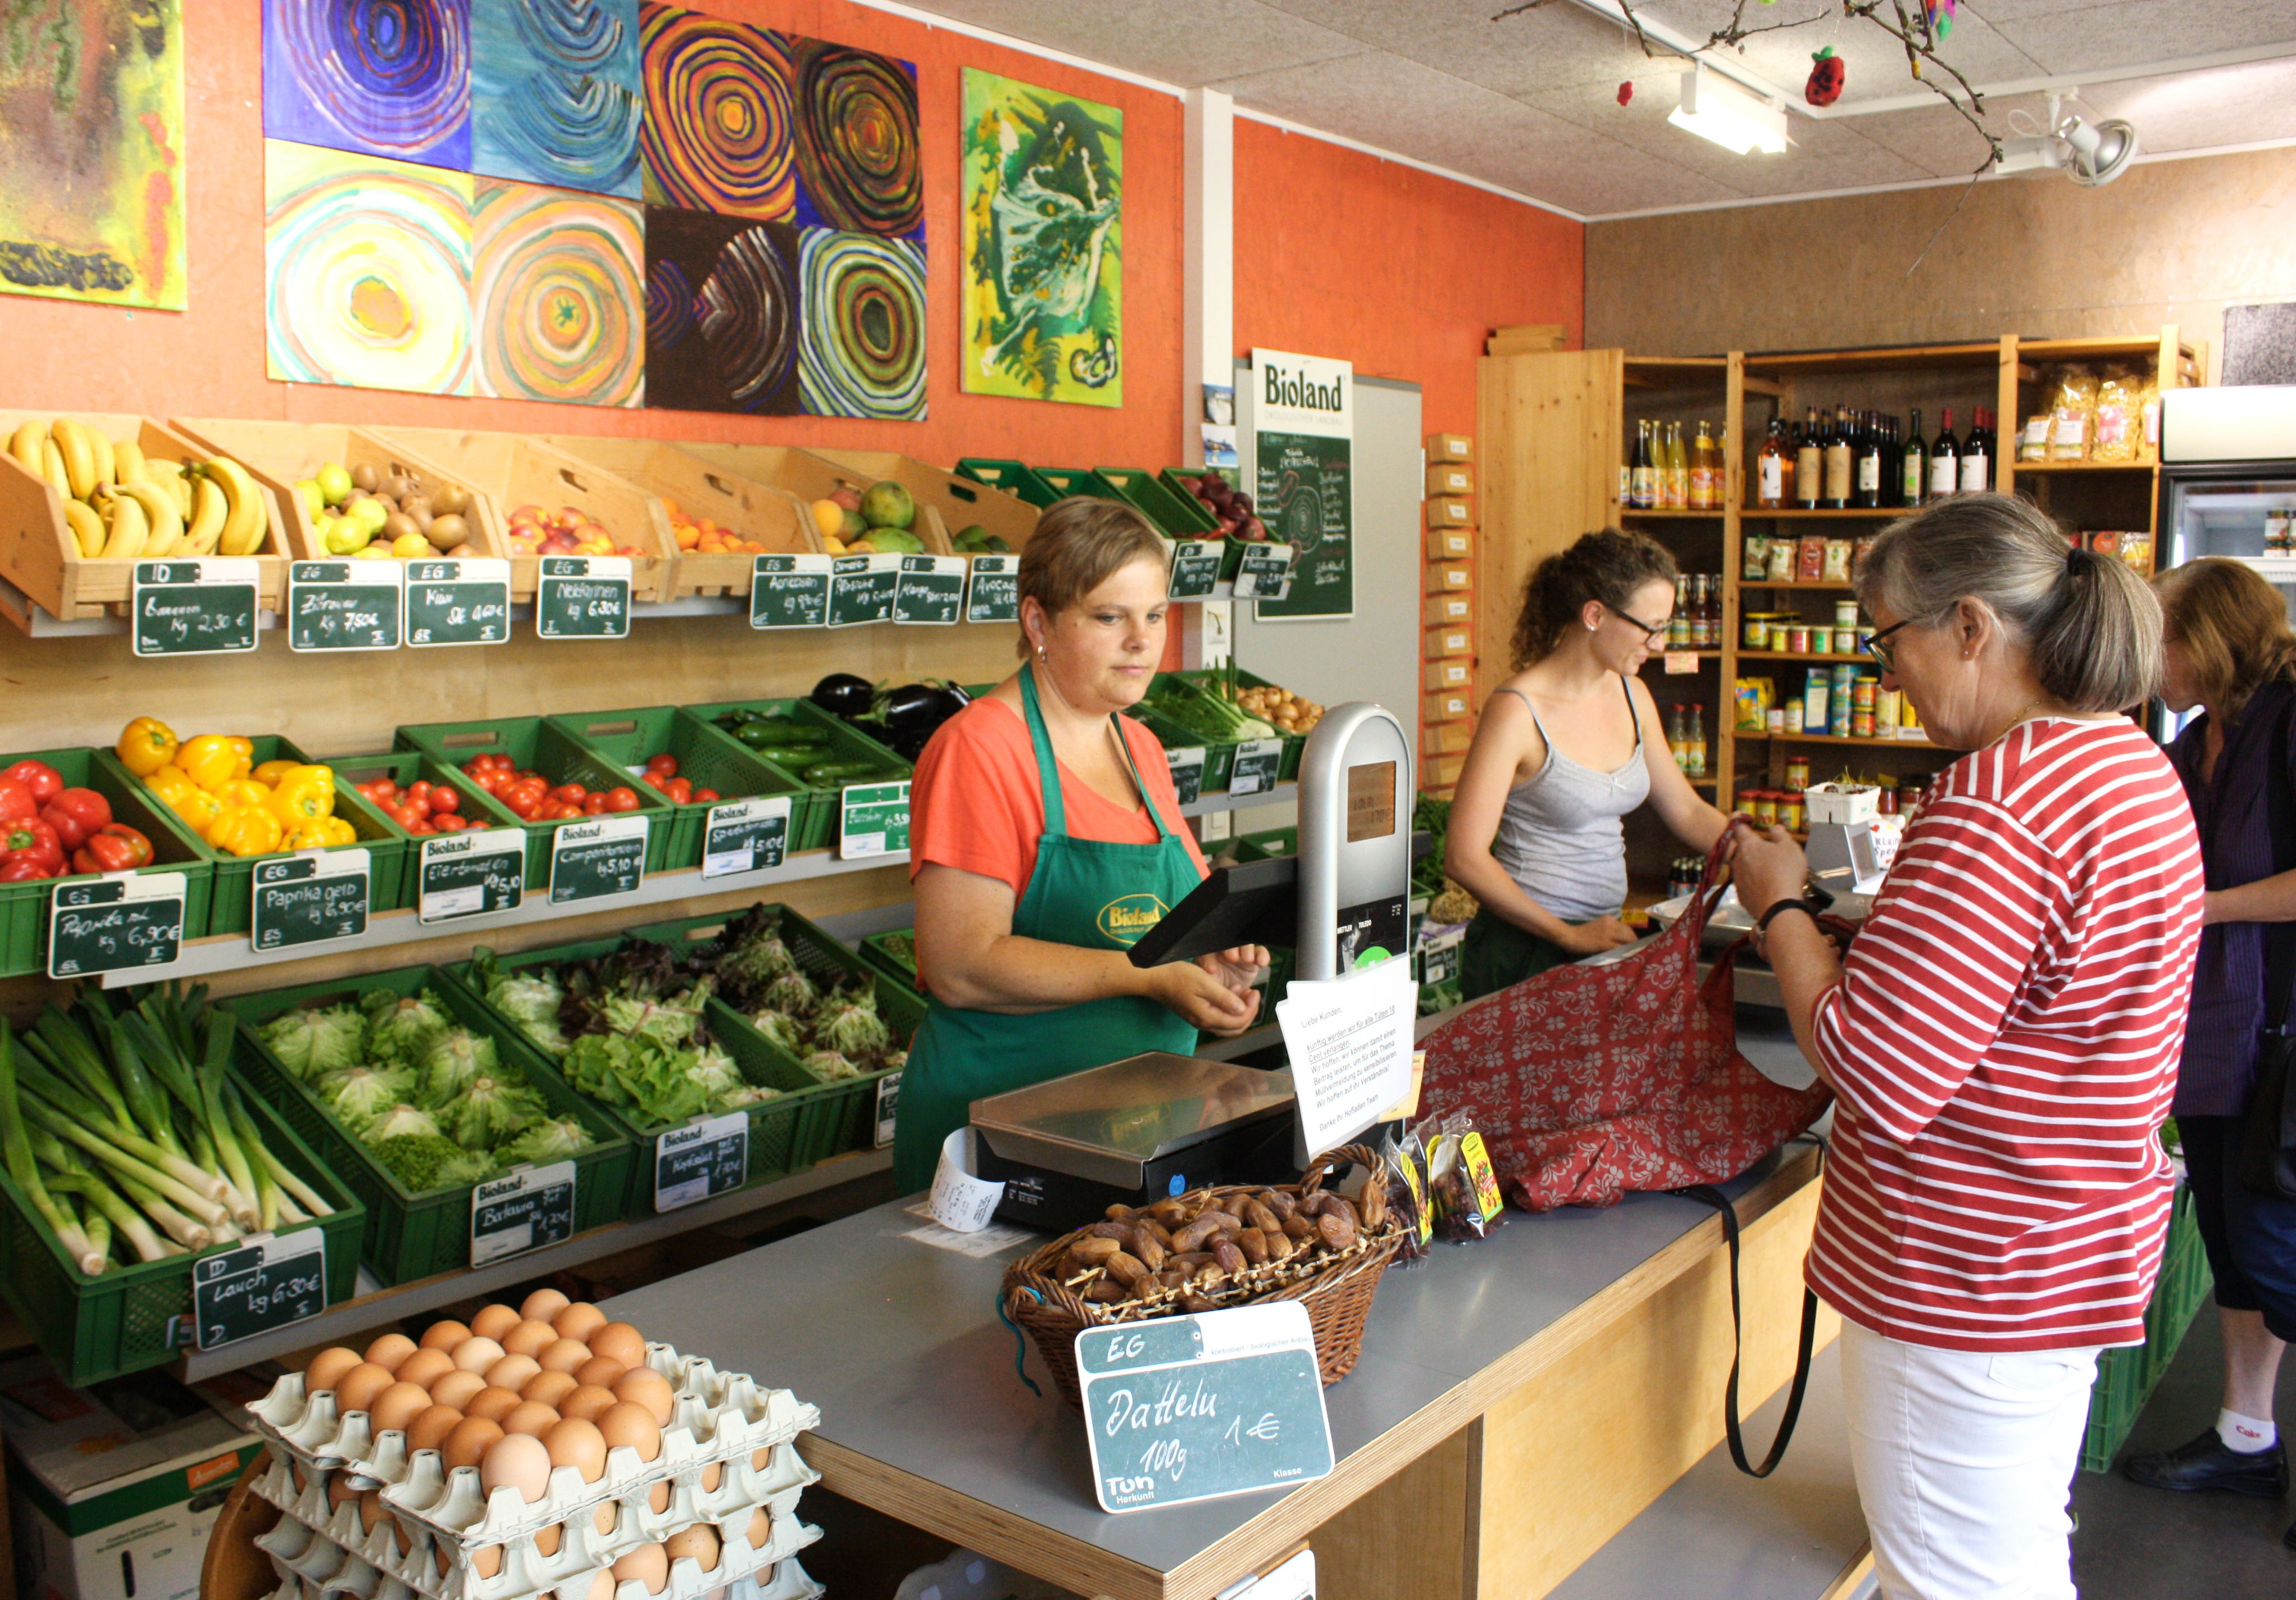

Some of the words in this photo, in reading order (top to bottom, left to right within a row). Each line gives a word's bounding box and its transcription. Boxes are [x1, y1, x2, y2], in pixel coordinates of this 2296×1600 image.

[1265, 364, 1342, 412] Bioland
[301, 566, 322, 579] EG
[421, 565, 445, 579] EG
[554, 560, 575, 575] EG
[713, 804, 748, 821] Bioland
[562, 824, 601, 840] Bioland
[428, 836, 471, 857] Bioland
[265, 865, 288, 880] EG
[266, 887, 322, 911] Paprika
[1110, 903, 1161, 927] Bioland
[1337, 924, 1353, 934] METTLER
[1358, 919, 1372, 929] TOLEDO
[1301, 1016, 1319, 1028] Liebe
[1320, 1007, 1343, 1020] Kunden,
[1307, 1039, 1326, 1051] künftig
[1327, 1029, 1347, 1041] werden
[1365, 1015, 1374, 1025] alle
[1375, 1009, 1388, 1020] Tüten
[1389, 1004, 1395, 1013] 10
[1308, 1052, 1322, 1062] Cent
[1311, 1064, 1321, 1074] Wir
[1351, 1042, 1369, 1056] können
[1370, 1034, 1383, 1046] damit
[1384, 1028, 1396, 1039] einen
[1313, 1072, 1333, 1085] Beitrag
[1370, 1049, 1379, 1058] das
[1379, 1040, 1394, 1052] Thema
[1315, 1072, 1356, 1097] Müllvermeidung
[1316, 1098, 1325, 1108] Wir
[1327, 1090, 1343, 1103] hoffen
[1361, 1064, 1389, 1085] Verständnis!
[1319, 1118, 1336, 1131] Danke
[1344, 1102, 1366, 1117] Hofladen
[1366, 1094, 1379, 1105] Team
[664, 1125, 702, 1148] Bioland
[479, 1176, 521, 1201] Bioland
[214, 1267, 267, 1302] Lauch
[1107, 1334, 1145, 1362] EG
[1211, 1345, 1244, 1355] kontrolliert
[1105, 1378, 1217, 1438] Datteln
[1224, 1414, 1240, 1446] 1
[1245, 1412, 1280, 1439] €
[2236, 1425, 2261, 1438] Coke
[1139, 1438, 1188, 1482] 100g
[1116, 1490, 1156, 1505] Herkunft
[1273, 1466, 1302, 1479] Klasse
